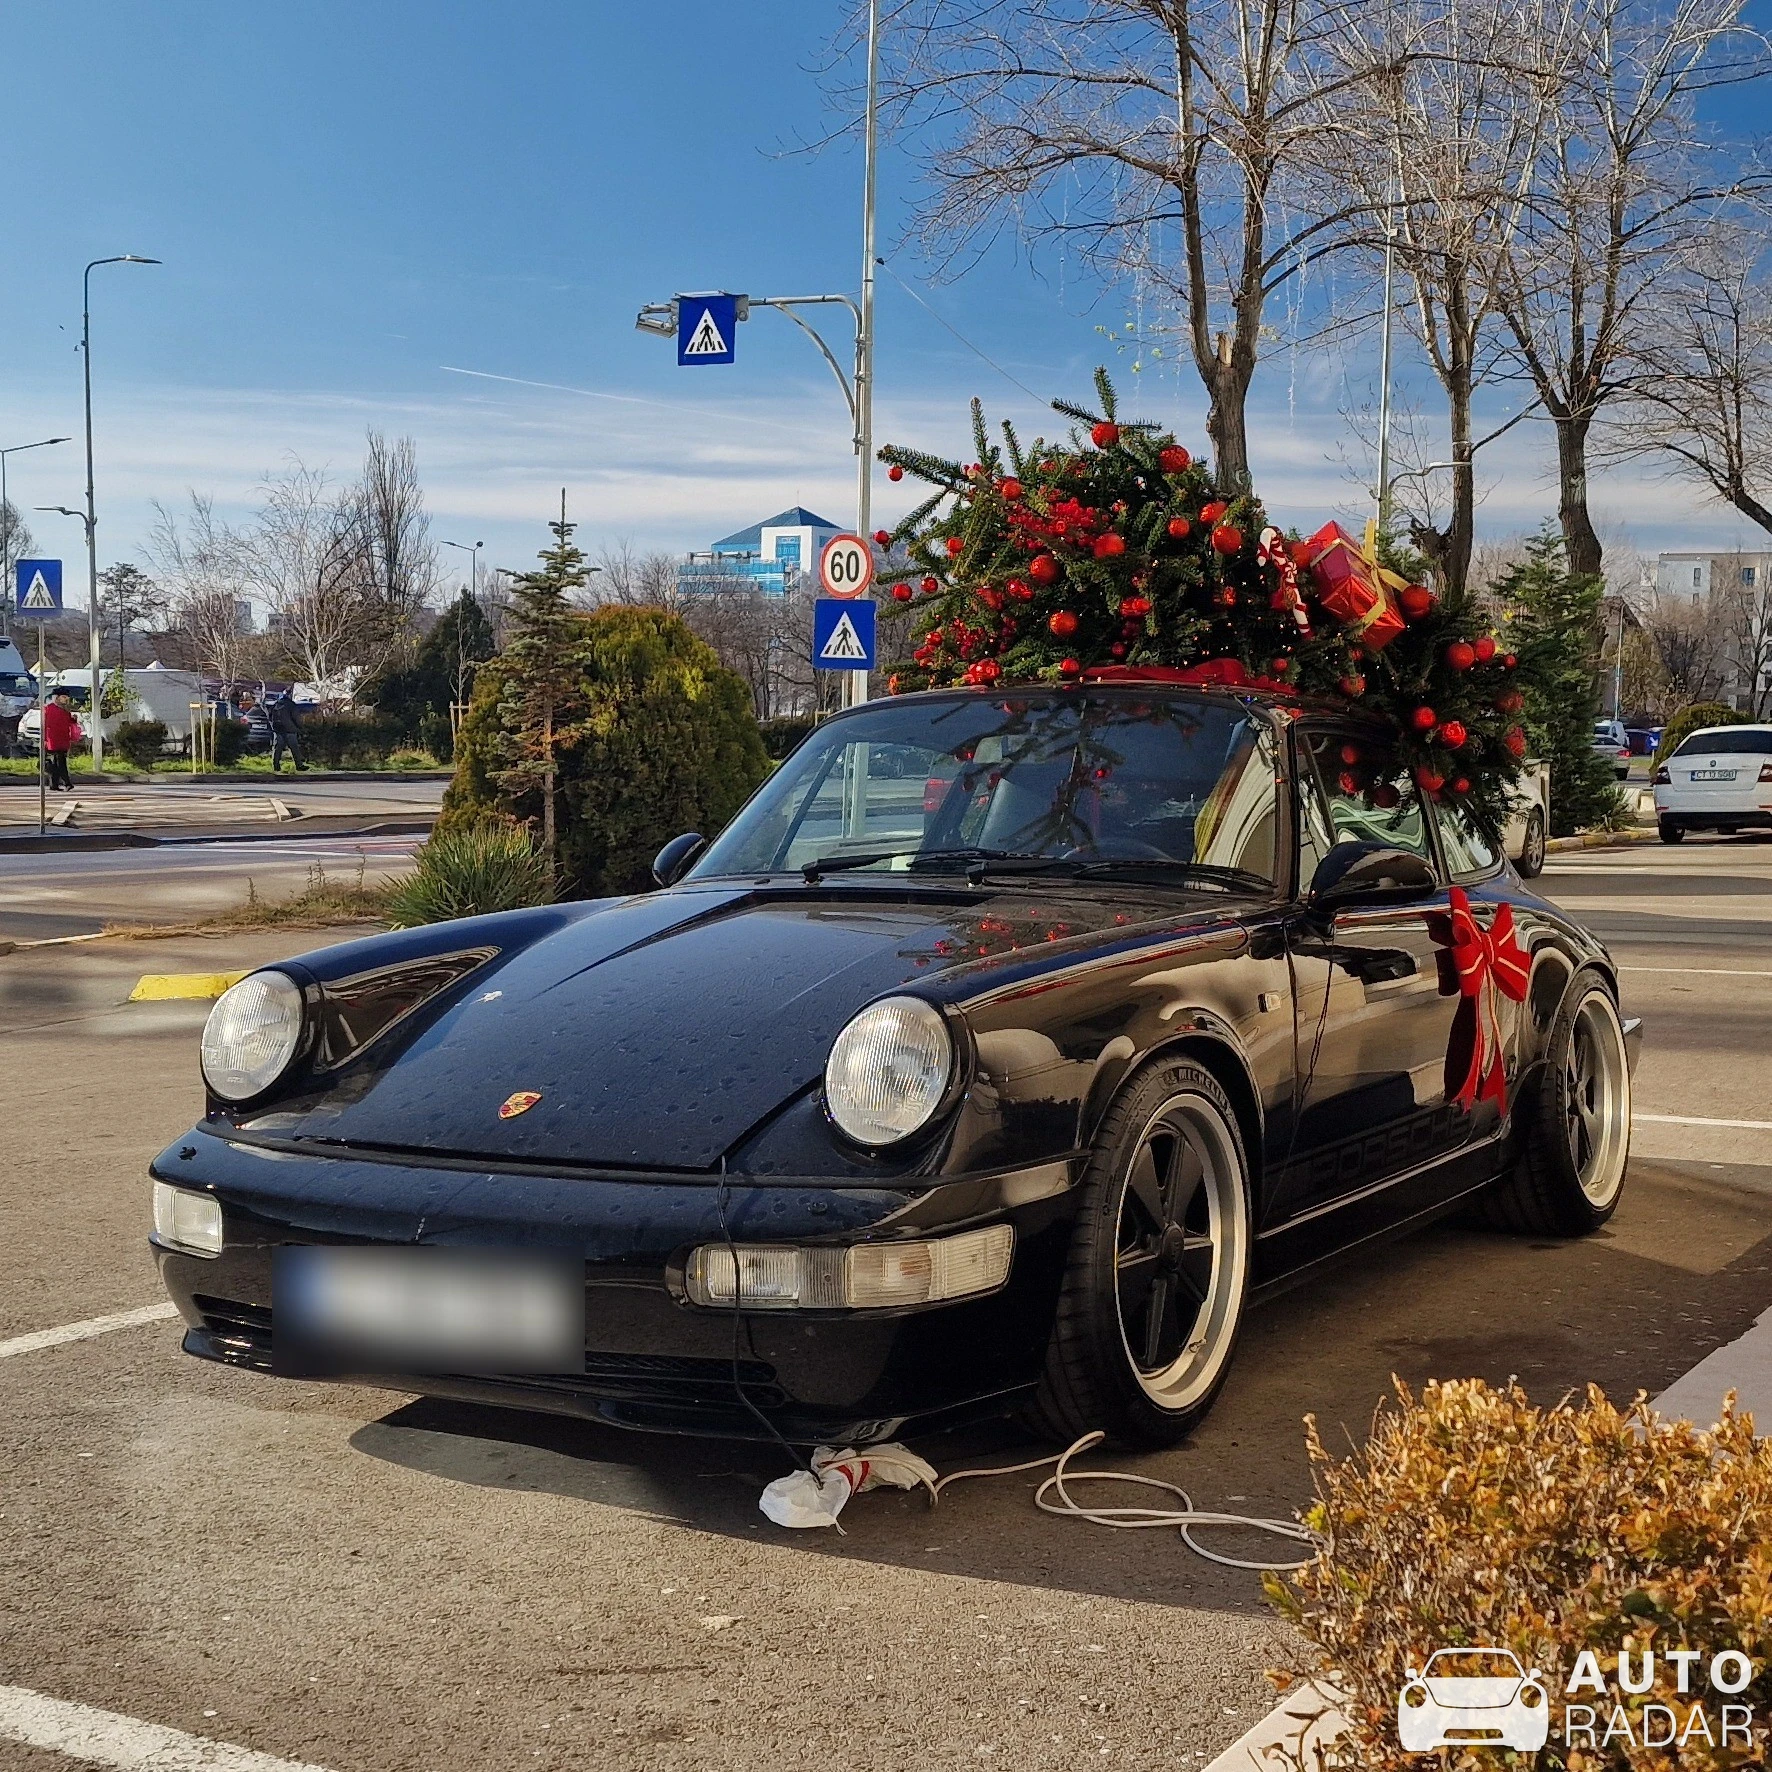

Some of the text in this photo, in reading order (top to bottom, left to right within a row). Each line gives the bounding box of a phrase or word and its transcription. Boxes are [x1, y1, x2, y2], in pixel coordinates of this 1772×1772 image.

[831, 551, 860, 583] 60
[1178, 1068, 1227, 1109] MICHELIN
[1312, 1107, 1472, 1186] PORSCHE
